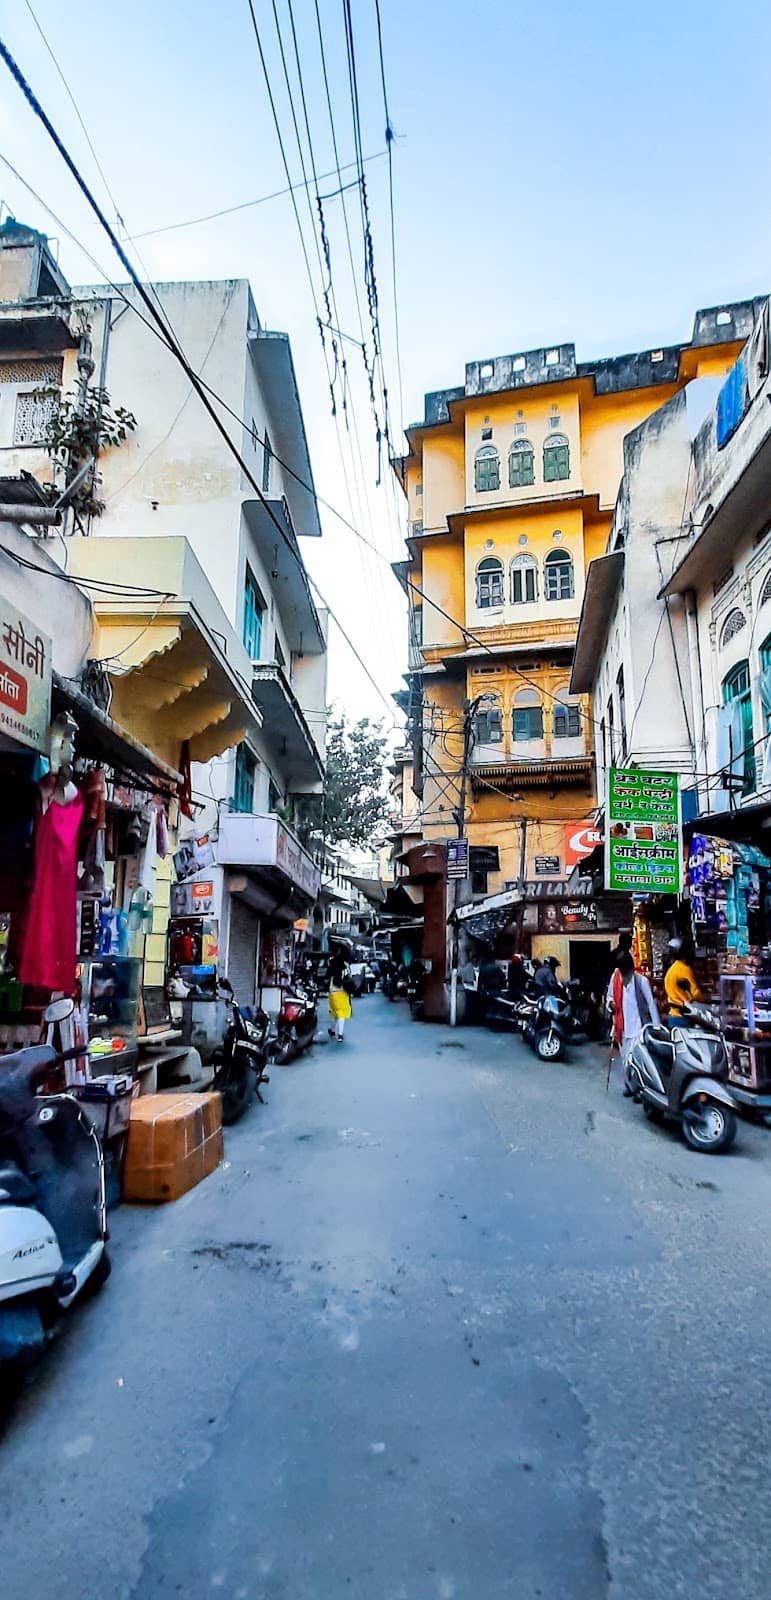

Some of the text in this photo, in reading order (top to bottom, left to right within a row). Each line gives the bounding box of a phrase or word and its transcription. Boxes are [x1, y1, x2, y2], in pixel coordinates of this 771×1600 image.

[3, 620, 46, 679] सोनी
[614, 785, 640, 797] केक
[560, 904, 589, 917] Beauty
